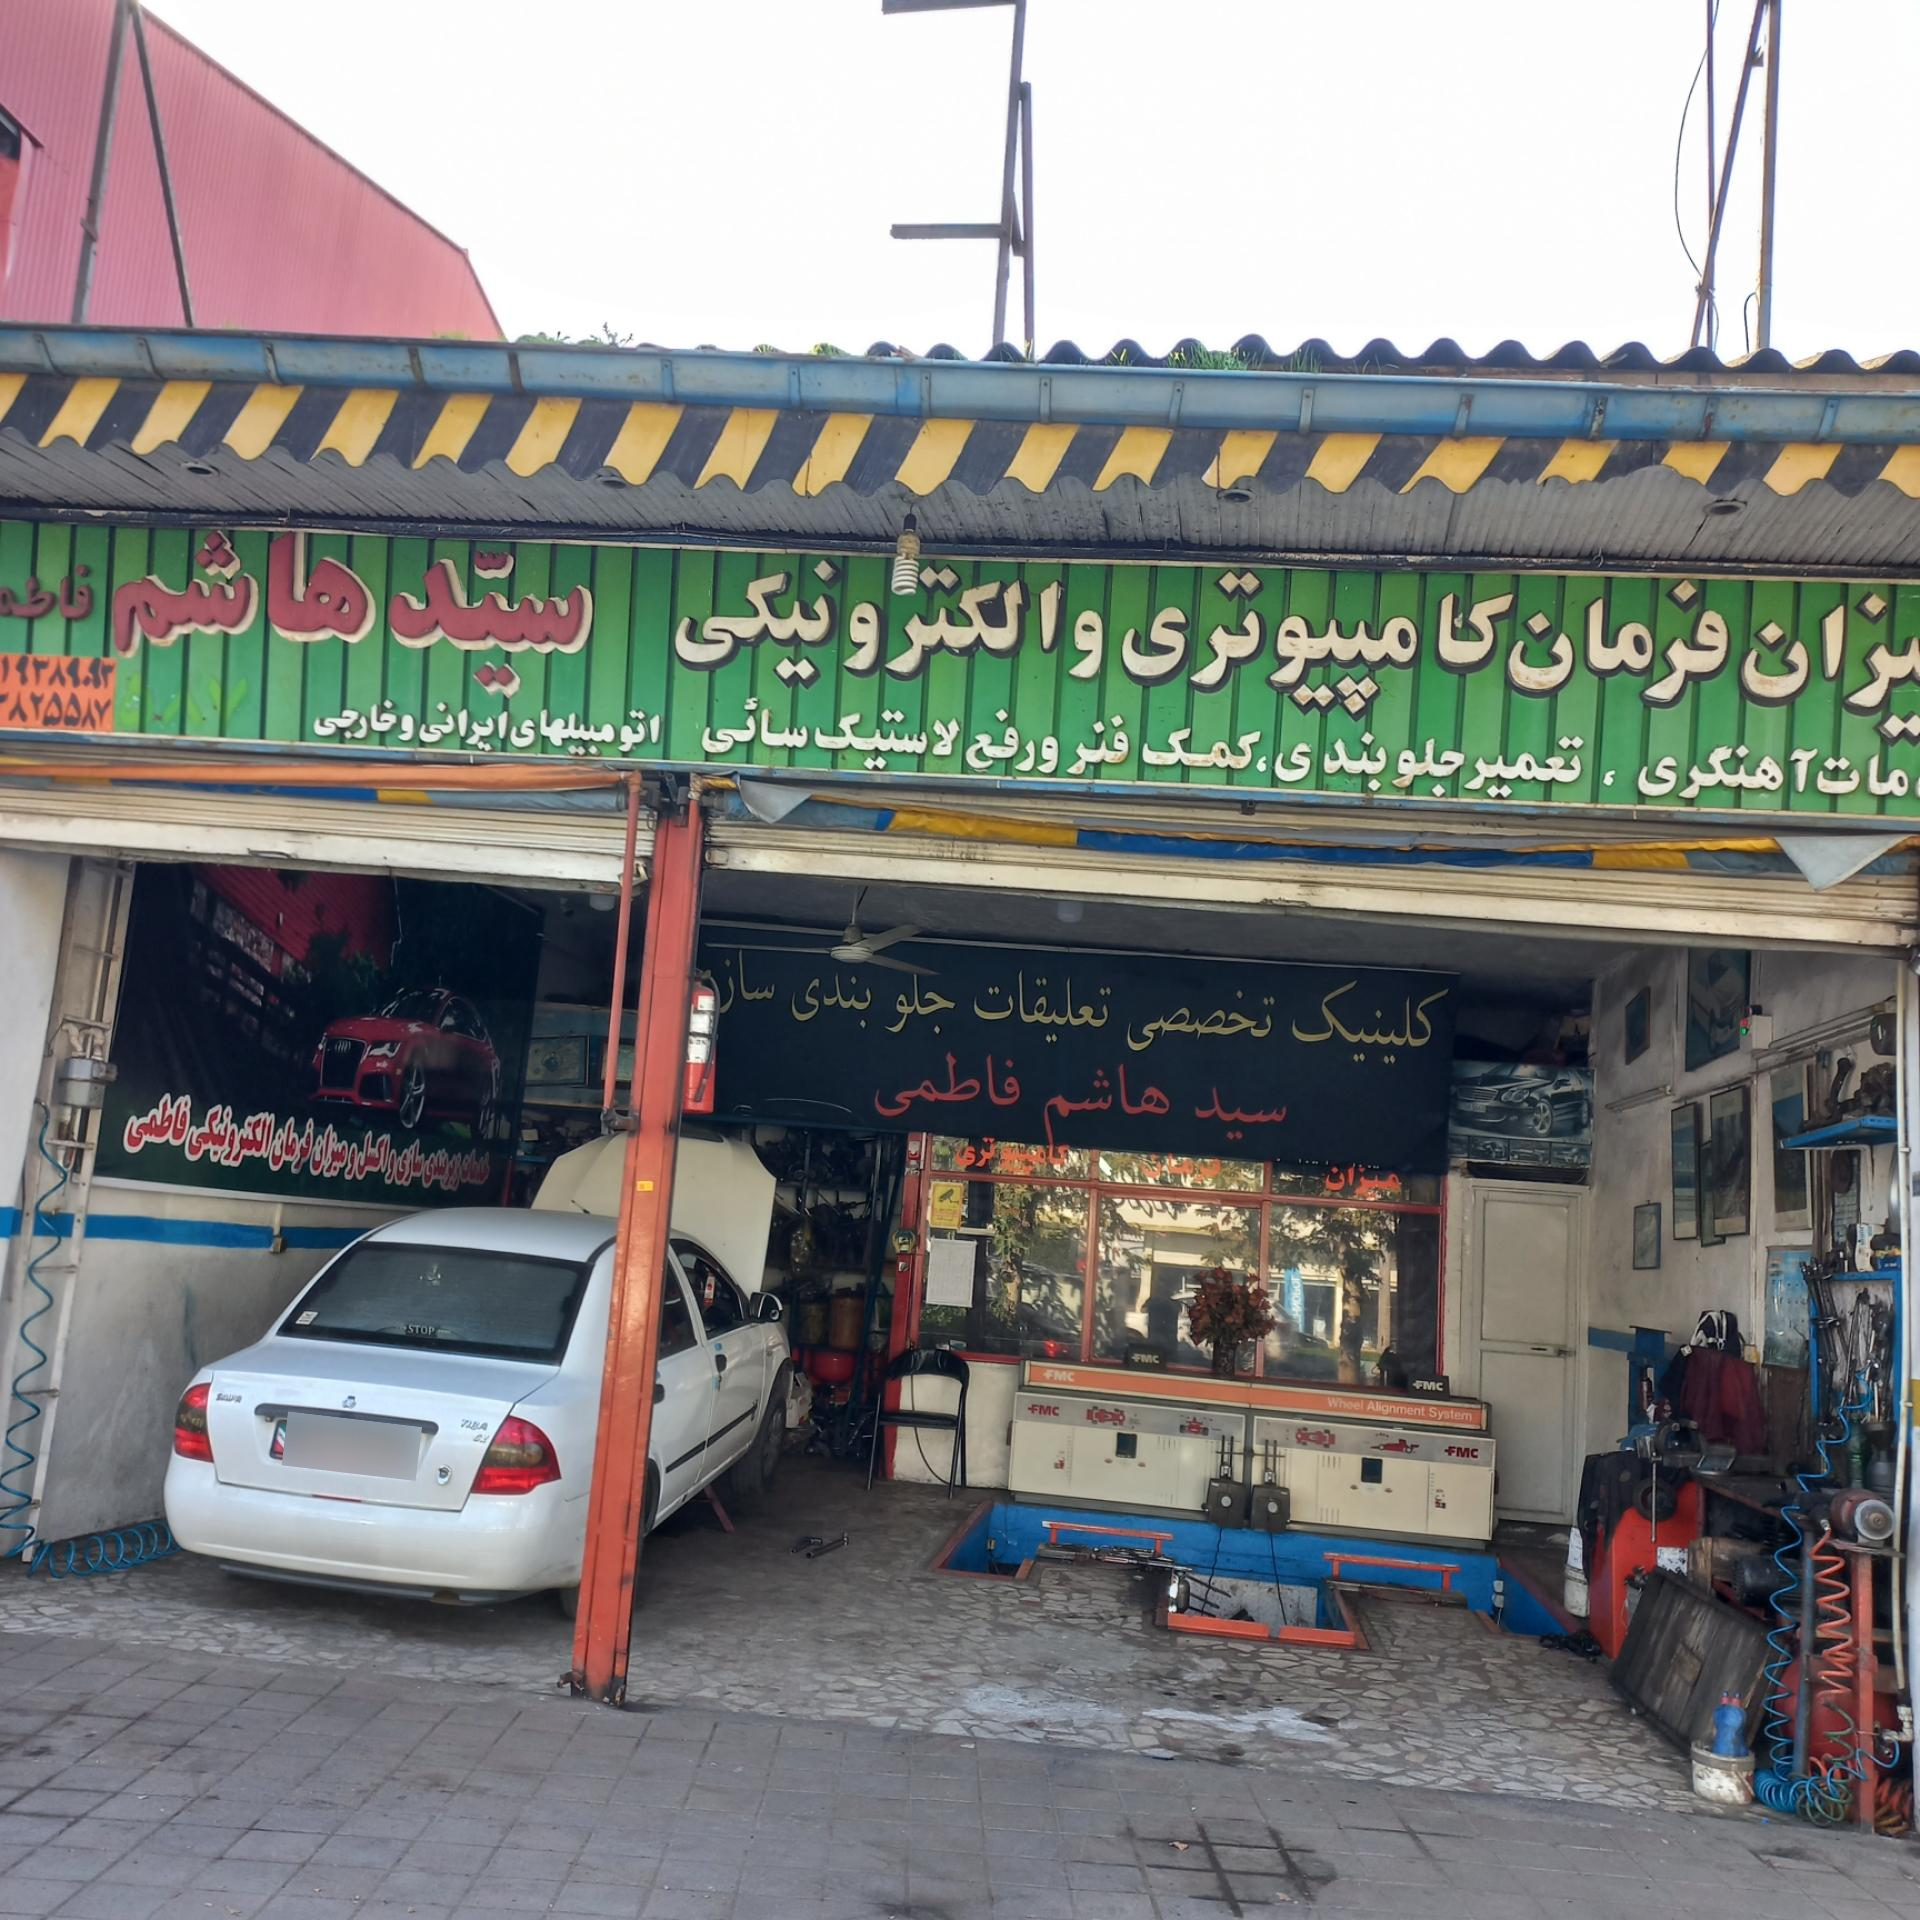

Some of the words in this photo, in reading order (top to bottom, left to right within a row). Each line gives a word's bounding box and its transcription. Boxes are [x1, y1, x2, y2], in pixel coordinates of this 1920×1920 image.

[0, 563, 93, 619] فاطم
[113, 530, 376, 658] هاشم
[675, 558, 1063, 687] الکترونیکی
[1122, 570, 1513, 717] کامپیوتری
[1507, 578, 1729, 705] فرمان
[1743, 592, 1920, 741] یزان
[313, 699, 397, 738] خارجی
[419, 702, 508, 750] ایرانی
[814, 709, 960, 769] لاستیک
[1066, 714, 1129, 775] فنر
[1142, 728, 1261, 769] کمک
[1464, 736, 1584, 798] تعمیر
[1637, 745, 1818, 798] آهنگری
[1816, 754, 1920, 798] مات
[720, 948, 775, 1014] ساز
[973, 969, 1112, 1043] تعلیقات
[1127, 990, 1274, 1051] تخصصی
[1292, 980, 1449, 1064] کلینیک
[875, 1052, 1021, 1117] فاطمی
[1043, 1063, 1171, 1148] هاشم
[1195, 1087, 1287, 1140] سید
[123, 1093, 192, 1154] فاطمی
[408, 1324, 436, 1336] STOP
[1132, 1354, 1160, 1365] FMC
[1043, 1369, 1076, 1382] FMC
[1412, 1380, 1443, 1392] FMC
[1028, 1404, 1060, 1417] FMC
[1327, 1396, 1365, 1411] Wheel
[1366, 1399, 1426, 1419] Alignment
[1428, 1406, 1473, 1422] System
[1444, 1445, 1479, 1459] FMC
